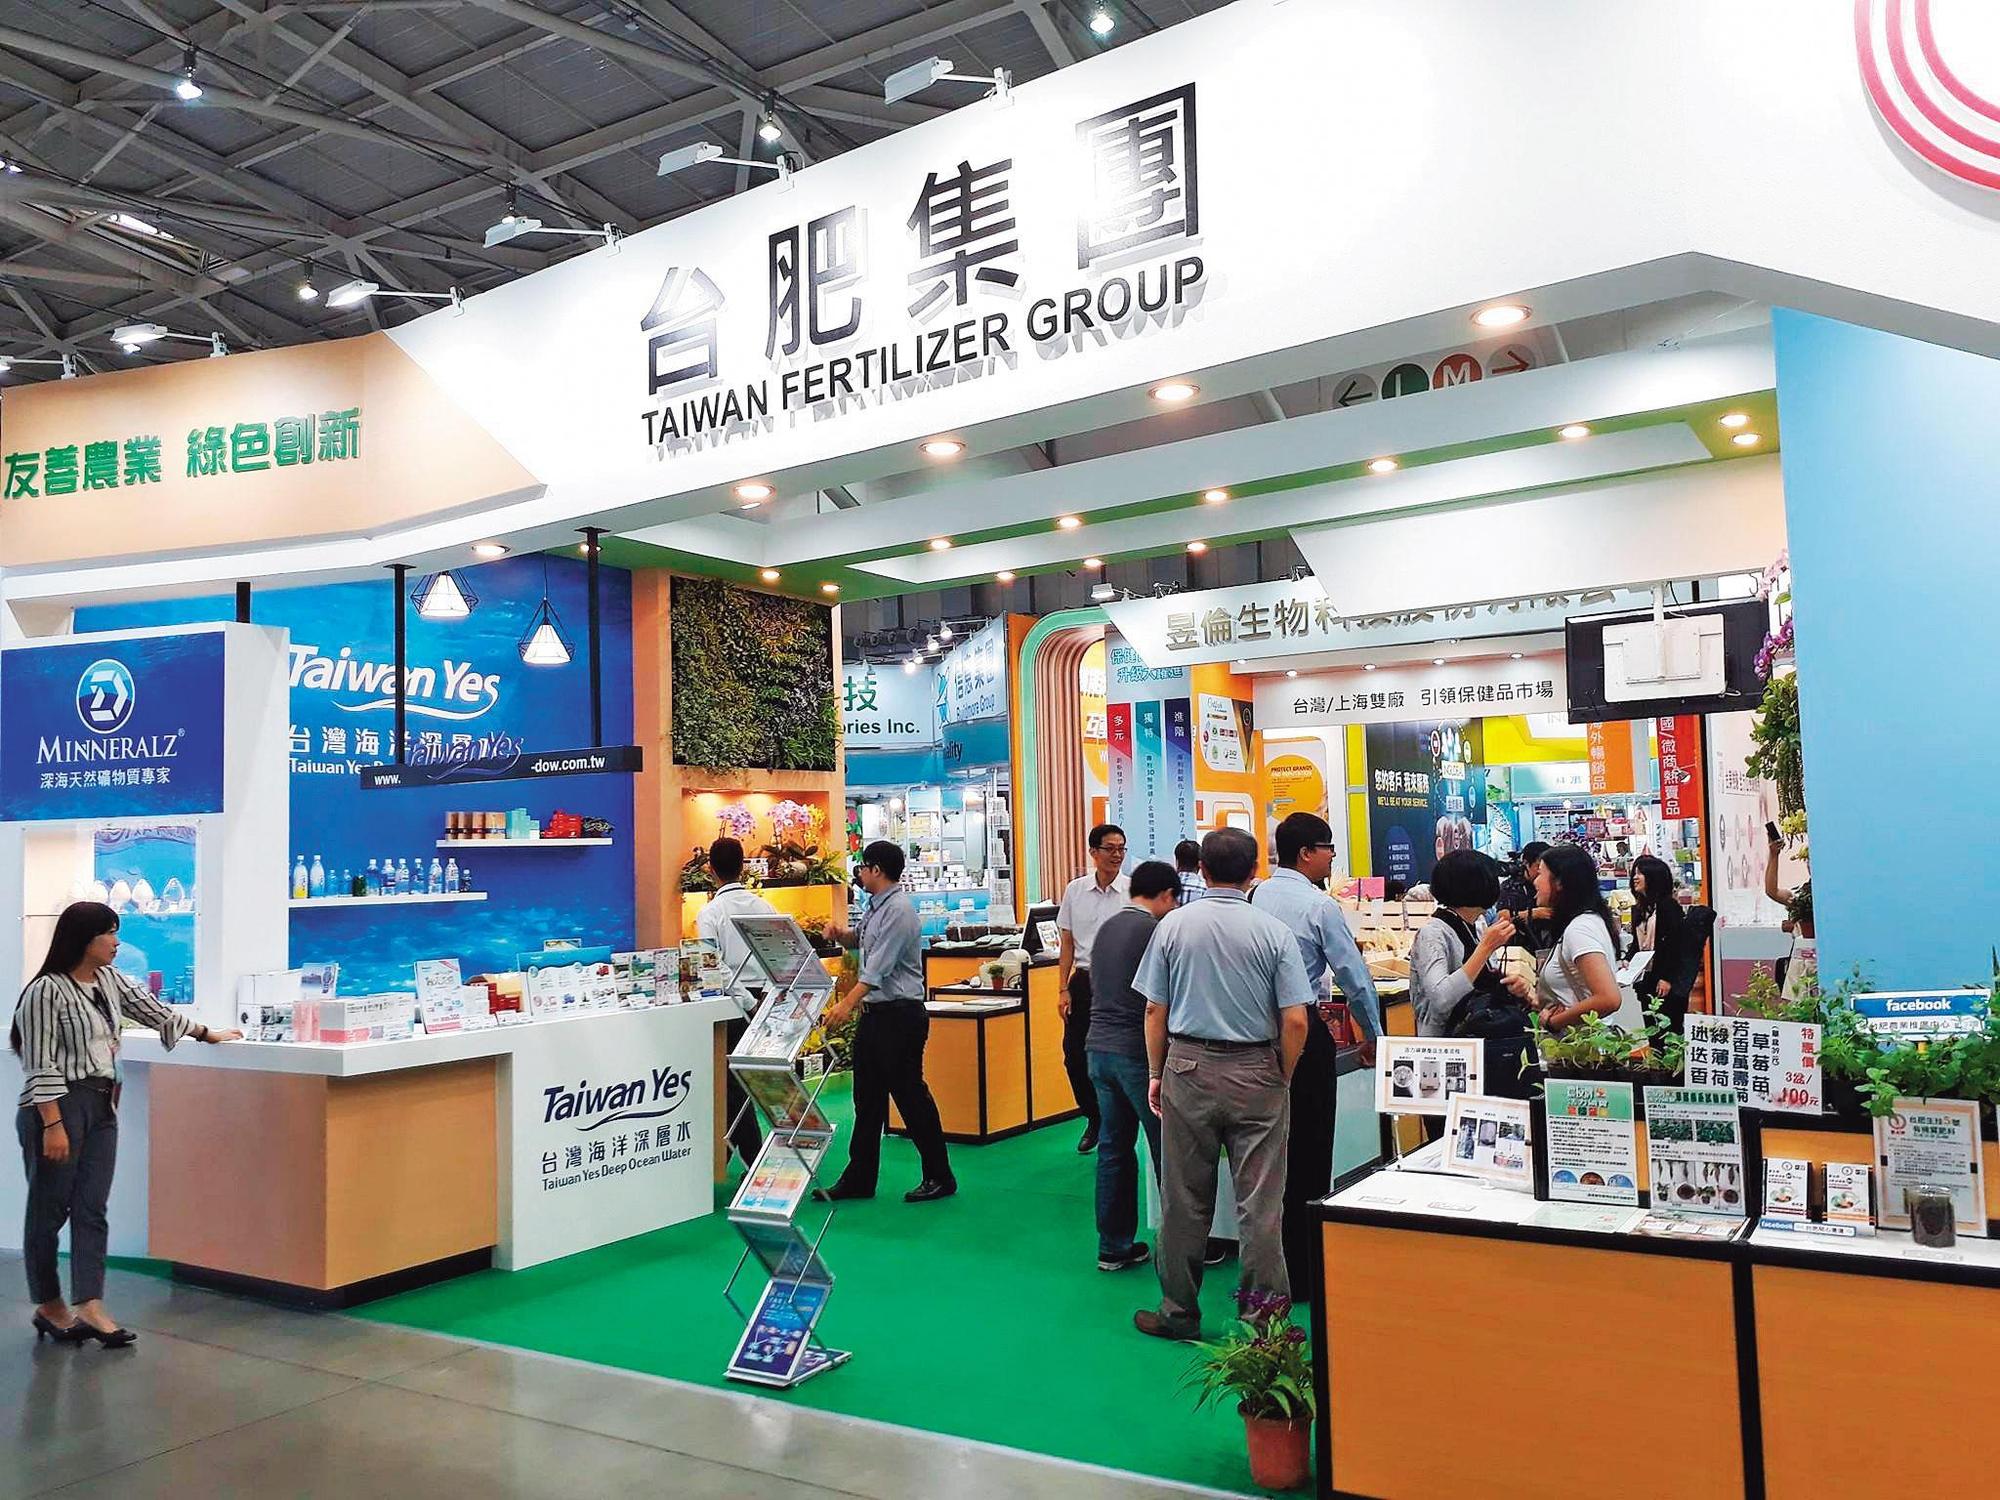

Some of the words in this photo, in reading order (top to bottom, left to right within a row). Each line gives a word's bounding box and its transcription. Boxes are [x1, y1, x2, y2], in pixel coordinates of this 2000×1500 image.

[641, 81, 1200, 396] 台肥集團
[641, 379, 768, 446] TAIWAN
[782, 311, 1010, 411] FERTILIZER
[1026, 255, 1205, 342] GROUP
[1443, 361, 1471, 389] M
[4, 434, 162, 500] 友善農業
[185, 407, 362, 478] 綠色創新
[289, 644, 436, 699] Taiwan
[443, 659, 501, 703] Yes
[1293, 691, 1405, 714] 台灣/上海雙廠
[1421, 680, 1554, 706] 引領保健品市場
[842, 719, 881, 734] ries
[887, 718, 920, 734] Inc.
[1113, 715, 1125, 741] 多元
[40, 766, 171, 789] 深海天然礦物質專家
[290, 758, 344, 775] Taiwan
[530, 755, 605, 773] -dow.com.tw
[1886, 998, 1952, 1012] facebook
[1711, 1026, 1729, 1087] 綠薄荷
[1752, 1033, 1770, 1094] 草莓苗
[544, 1080, 646, 1123] Taiwan
[652, 1066, 692, 1101] Yes
[542, 1120, 691, 1174] 台灣海洋深層水
[542, 1173, 581, 1191] Taiwan
[583, 1168, 600, 1182] Yes
[602, 1161, 628, 1177] Deep
[628, 1153, 660, 1170] Ocean
[662, 1147, 691, 1162] Water
